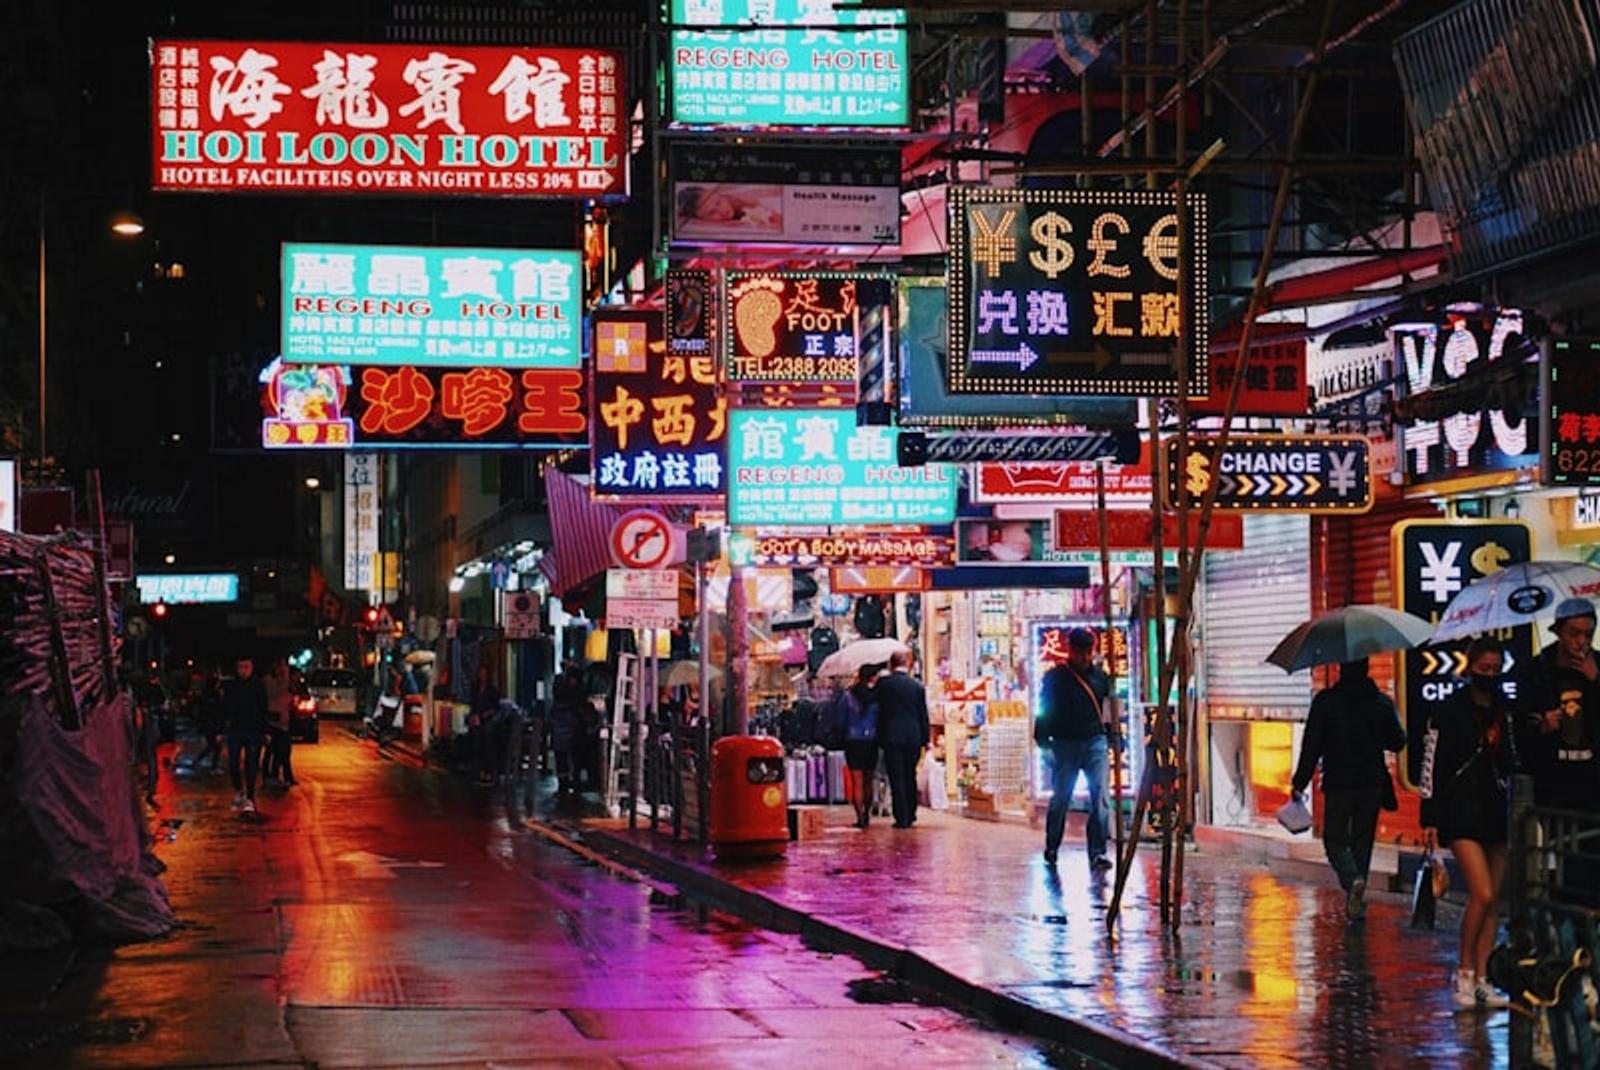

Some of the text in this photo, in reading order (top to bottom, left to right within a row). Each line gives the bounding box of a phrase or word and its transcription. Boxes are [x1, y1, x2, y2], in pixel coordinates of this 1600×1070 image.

[676, 48, 900, 69] REGENG HOTEL
[209, 47, 572, 133] 海龍賓館
[160, 130, 618, 169] HOI LOON HOTEL
[161, 168, 233, 186] HOTEL
[357, 170, 412, 187] OVER
[417, 170, 484, 188] NIGHT
[487, 172, 540, 188] LESS
[543, 173, 573, 188] 20%
[793, 191, 877, 202] Health Massage
[971, 209, 1180, 281] ¥ $ £ €
[291, 252, 573, 301] 麗晶賓館
[294, 297, 568, 321] REGENG HOTEL
[787, 313, 847, 332] FOOT
[977, 290, 1070, 335] 兑换
[600, 452, 722, 489] 政府註冊
[737, 465, 948, 484] REGENG HOTEL
[1186, 451, 1357, 497] $ CHANGE ¥
[753, 538, 800, 556] FOOT
[811, 538, 857, 556] BODY
[859, 538, 937, 557] MASSAGE
[1418, 542, 1462, 602] ¥
[1422, 682, 1518, 701] CHE
